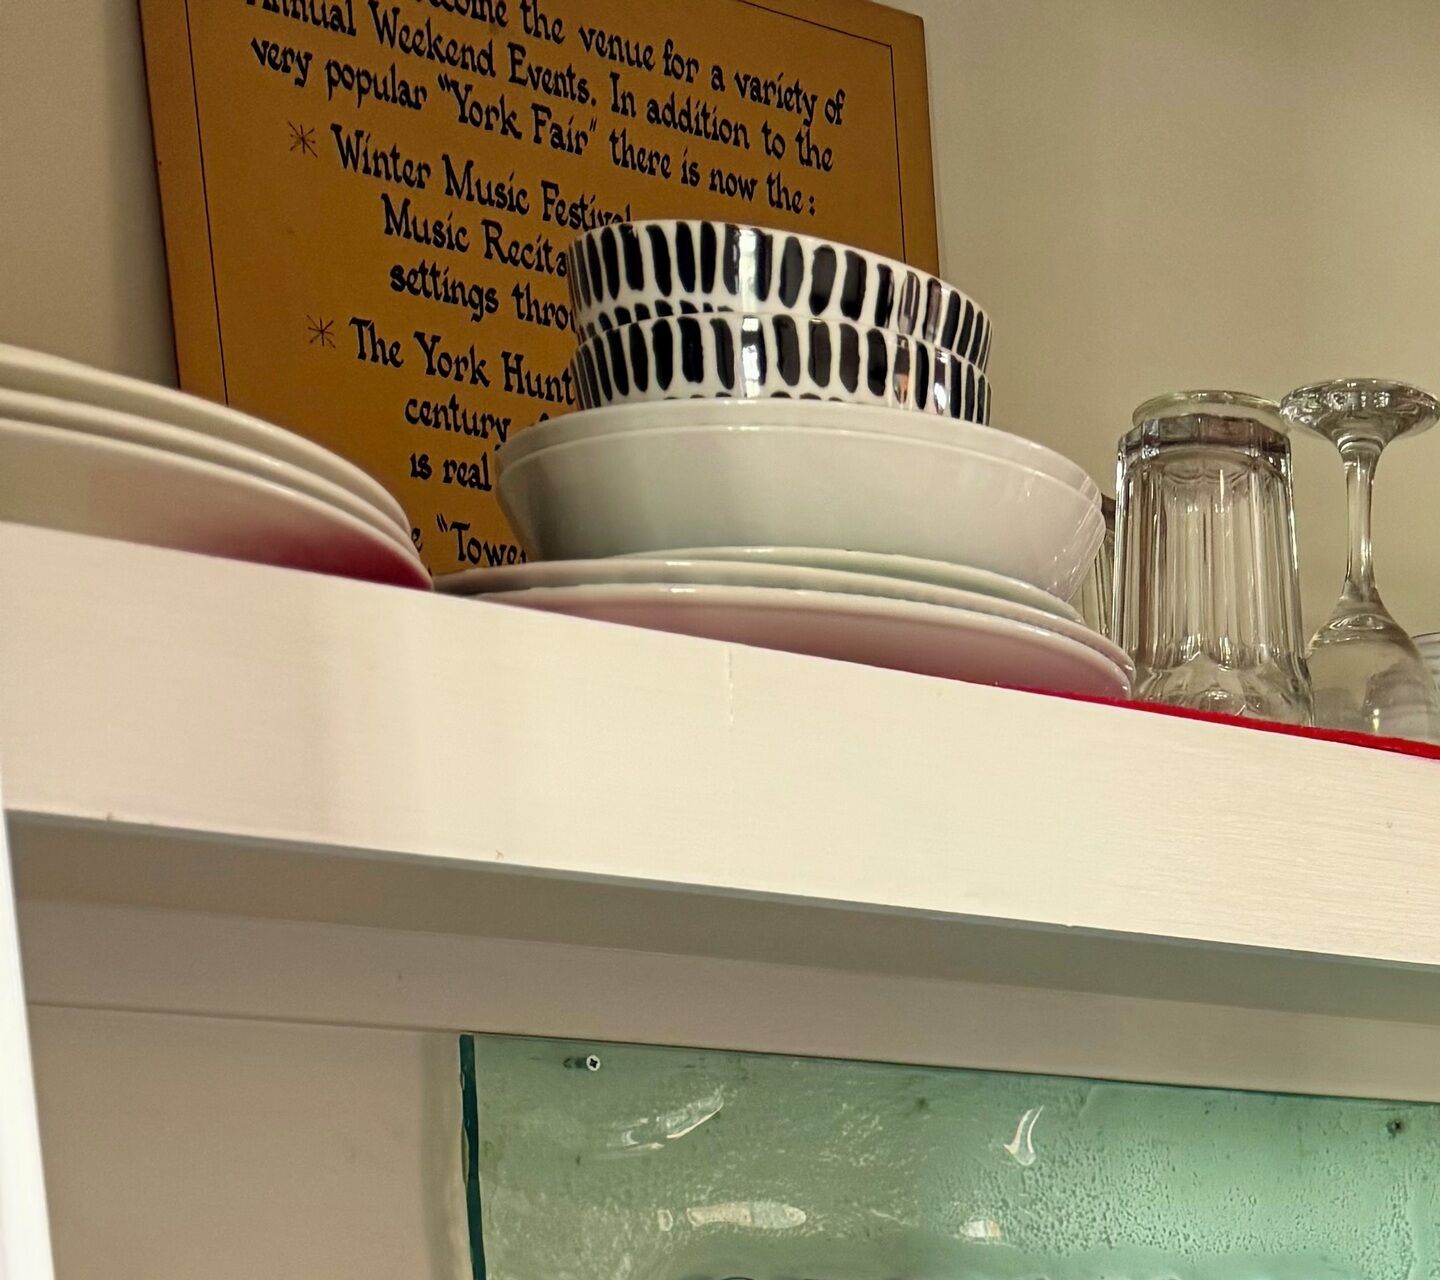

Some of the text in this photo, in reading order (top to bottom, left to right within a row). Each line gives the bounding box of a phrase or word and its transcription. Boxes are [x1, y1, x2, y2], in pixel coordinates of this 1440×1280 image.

[246, 0, 833, 172] nnual Weekend Events. In addition to the
[520, 0, 565, 44] the
[578, 26, 655, 71] venue
[663, 39, 699, 84] for
[711, 65, 725, 91] a
[734, 72, 818, 126] variety
[824, 89, 846, 126] of
[251, 38, 312, 87] very
[324, 59, 428, 108] popular
[437, 72, 522, 140] "York
[531, 103, 598, 156] Fair"
[609, 128, 671, 179] there
[681, 148, 700, 187] is
[709, 167, 758, 202] now
[330, 123, 431, 189] Winter
[442, 153, 530, 216] Music
[380, 193, 470, 253] Music
[390, 259, 499, 322] settings
[349, 317, 575, 405] The York Hunt
[404, 394, 511, 450] century
[410, 452, 492, 492] is real
